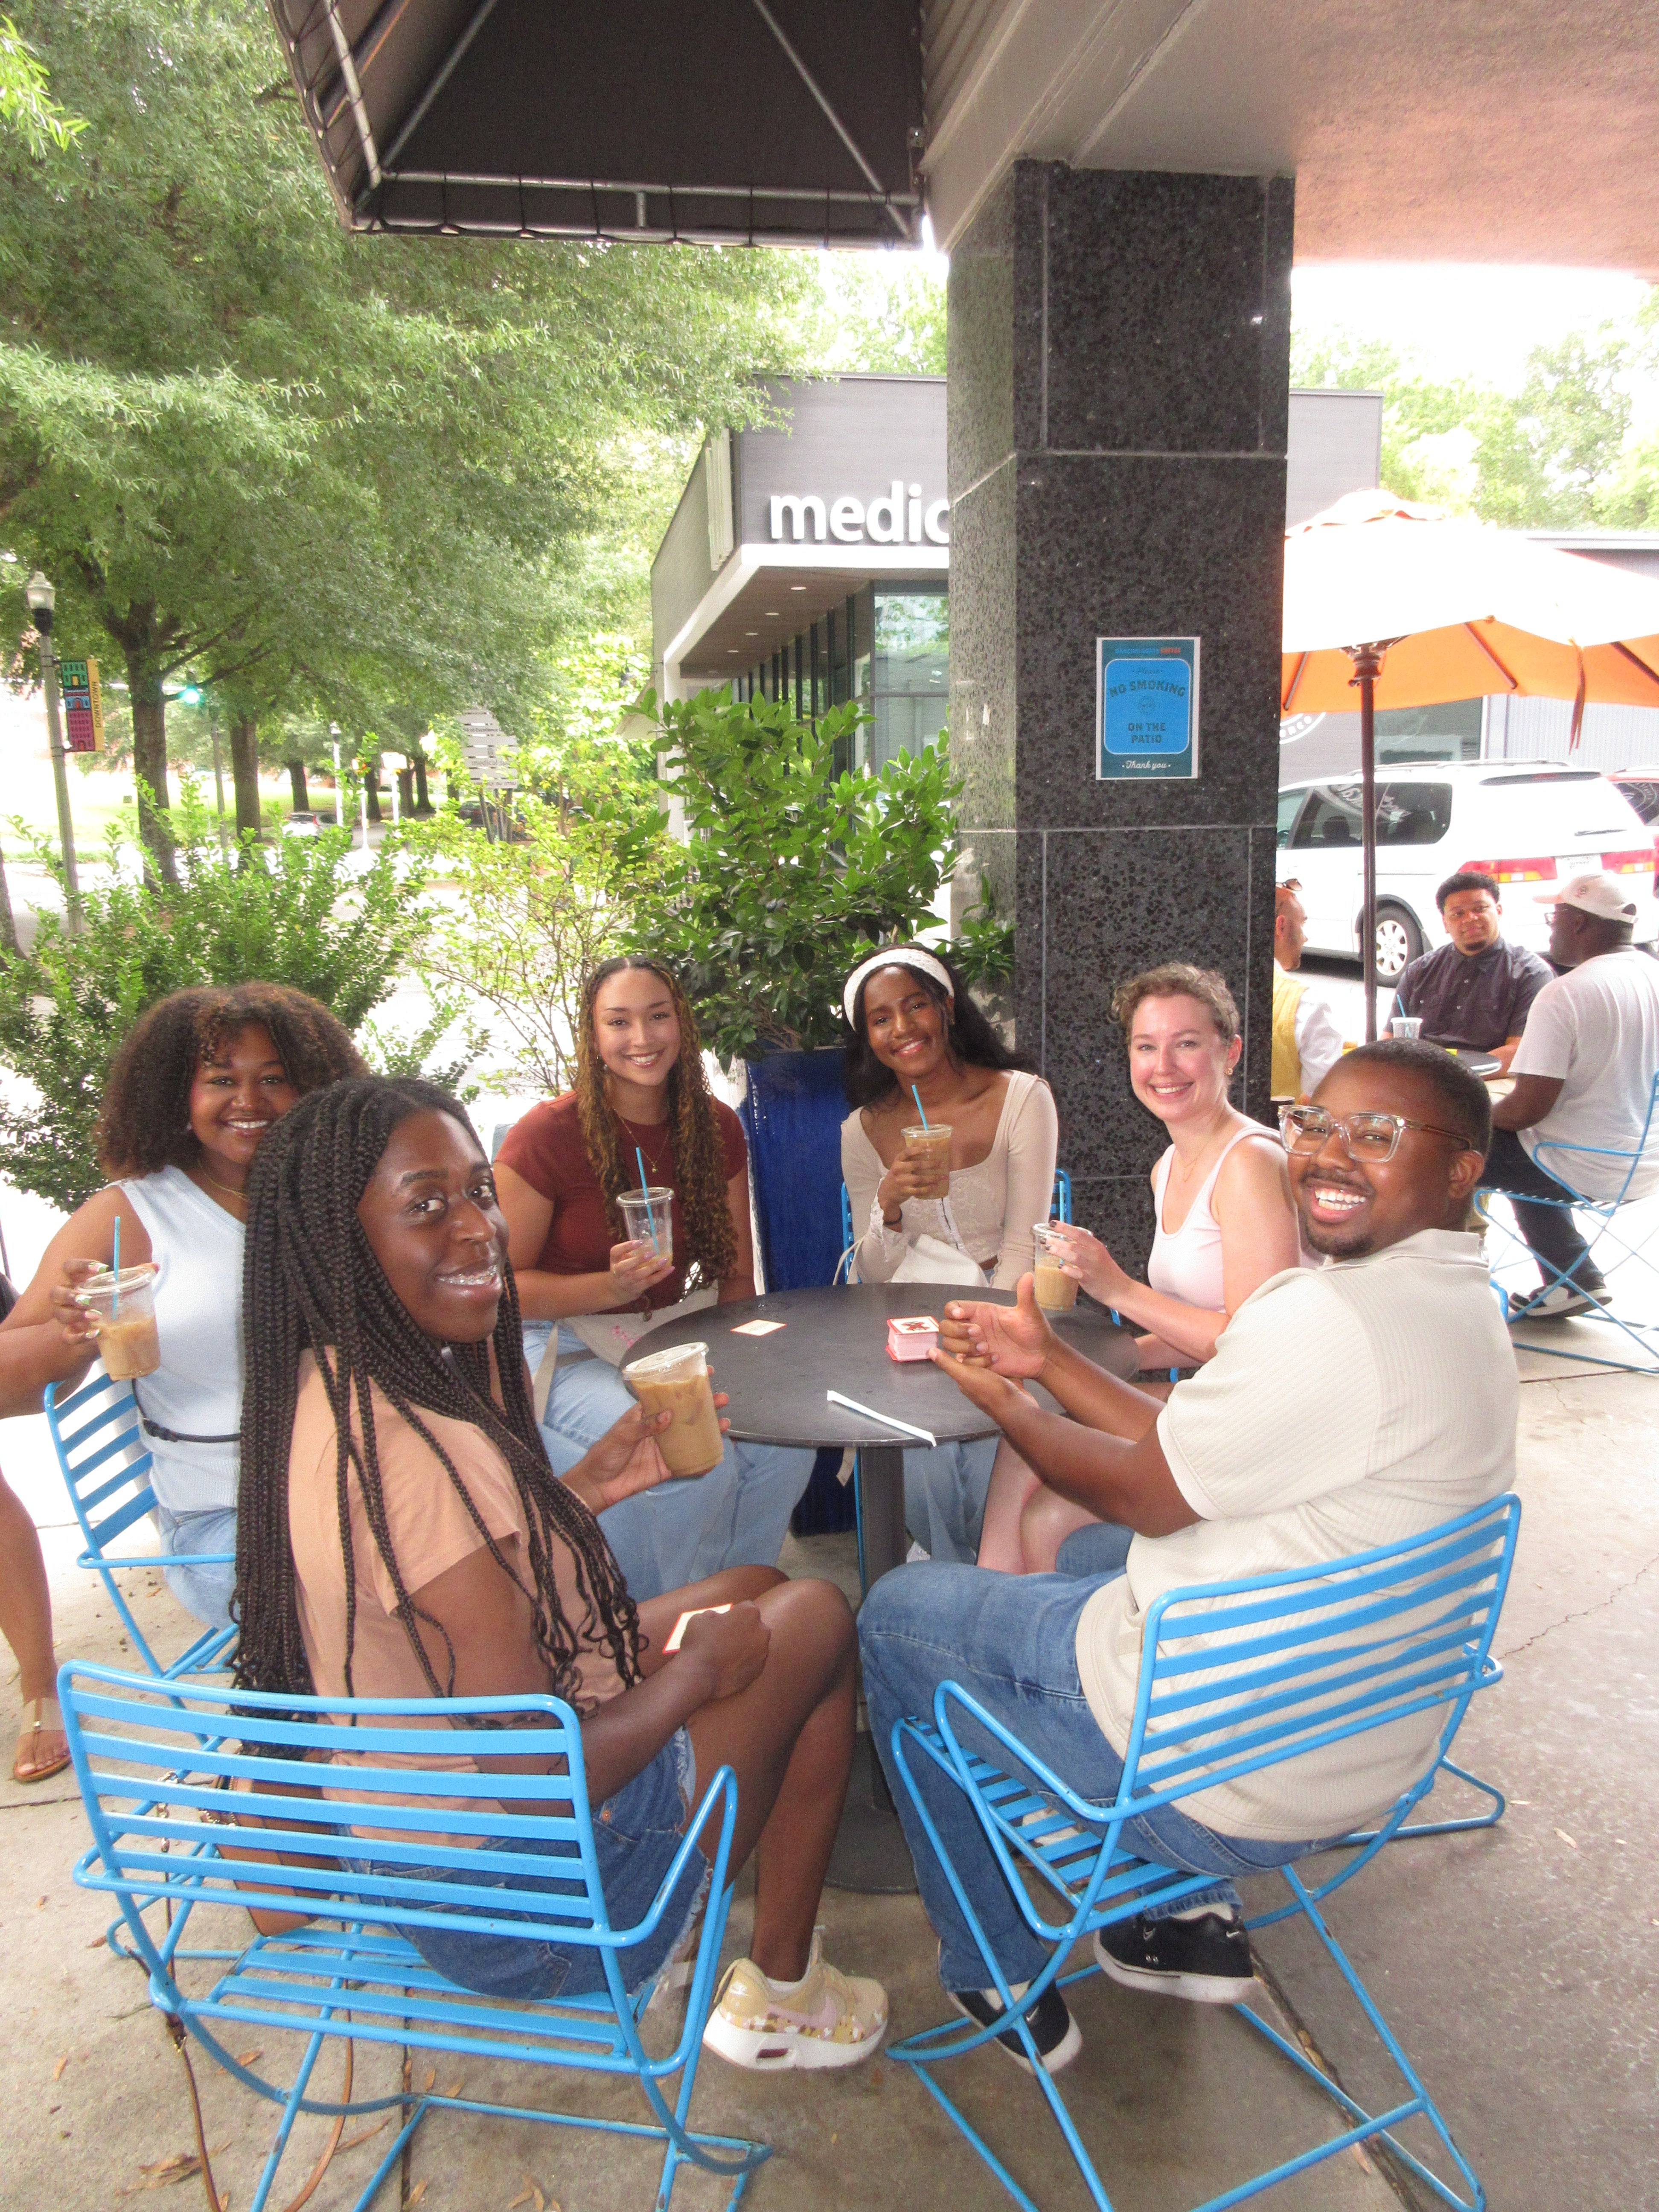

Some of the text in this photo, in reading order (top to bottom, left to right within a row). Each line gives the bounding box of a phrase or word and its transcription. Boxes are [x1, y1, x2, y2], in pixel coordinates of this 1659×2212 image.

[1109, 681, 1186, 697] NO SMOKING
[91, 681, 102, 728] DOWNTOWN
[1128, 722, 1166, 732] ON THE
[1131, 734, 1162, 744] PATIO
[1126, 760, 1167, 771] Thank you
